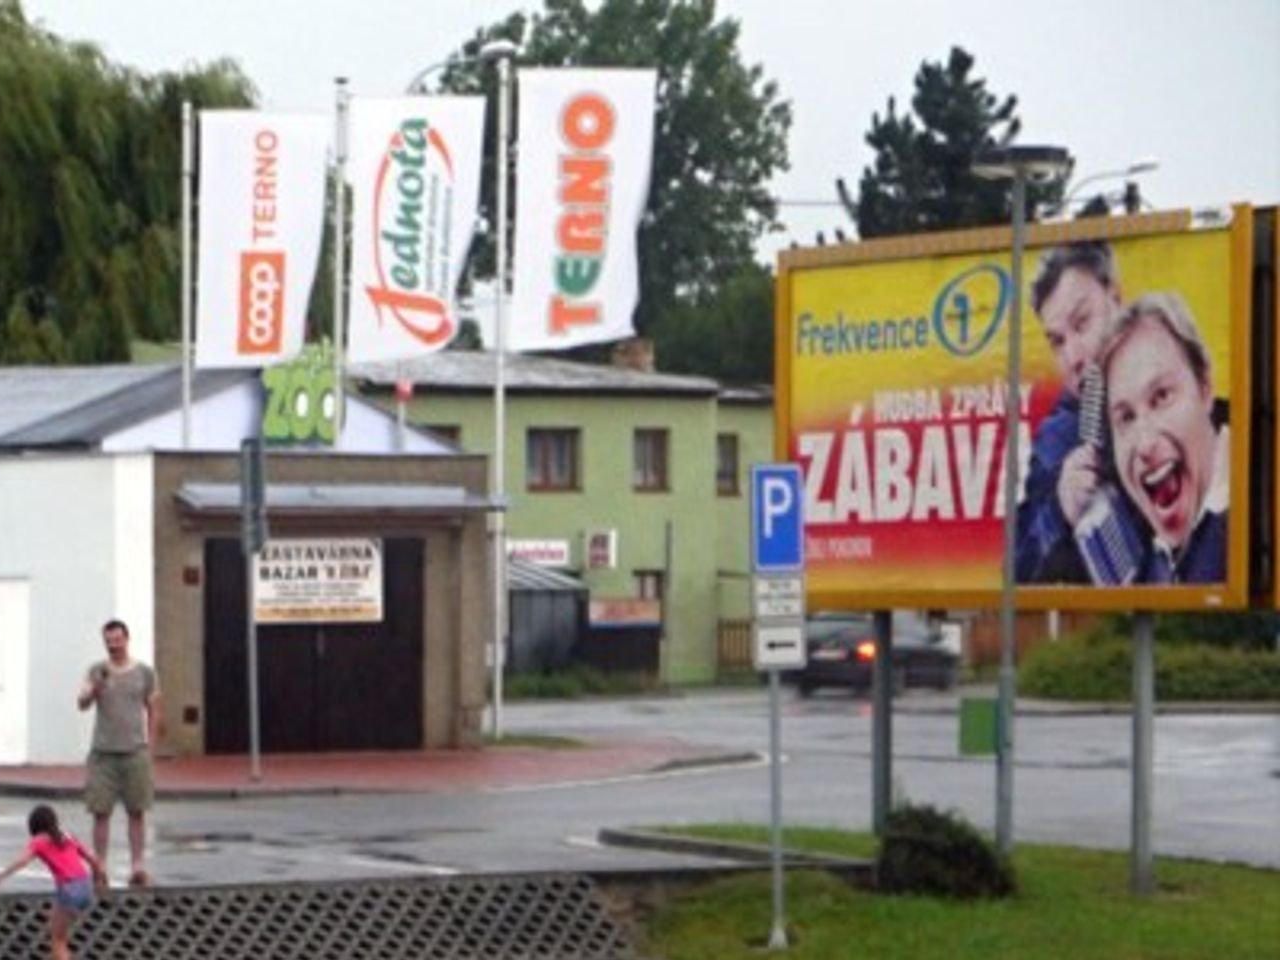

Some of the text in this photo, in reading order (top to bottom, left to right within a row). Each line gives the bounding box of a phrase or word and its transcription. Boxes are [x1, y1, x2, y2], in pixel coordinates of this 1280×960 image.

[252, 130, 279, 243] TERNO
[549, 91, 616, 336] TERNO
[366, 118, 454, 345] Jednota
[797, 312, 928, 356] Frekvence
[873, 377, 1032, 422] HUDBA ZPRÁY
[763, 477, 793, 538] P
[259, 565, 318, 581] BAZAR
